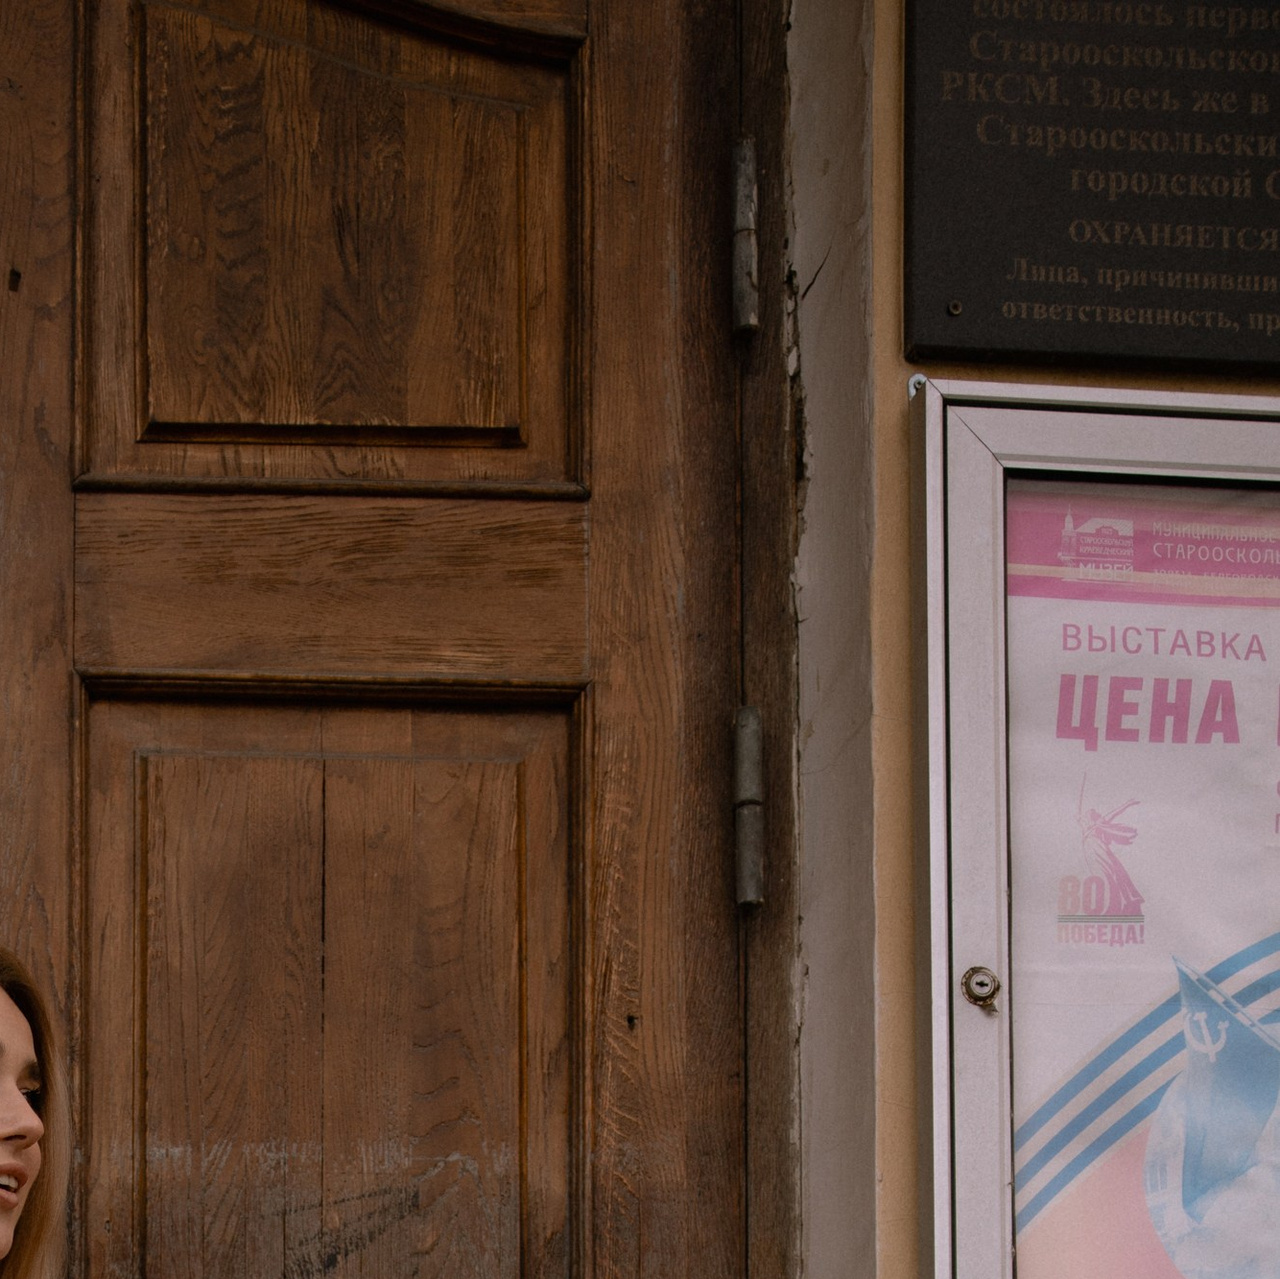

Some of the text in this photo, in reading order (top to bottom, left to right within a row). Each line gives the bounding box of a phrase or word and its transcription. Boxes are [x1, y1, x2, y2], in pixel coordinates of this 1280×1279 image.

[972, 0, 1174, 27] состоялось
[939, 70, 1270, 115] РКСМ. Здесь же в
[1070, 168, 1252, 200] городской
[1068, 219, 1279, 252] ОХРАНЯЕТСЯ
[1006, 257, 1089, 288] Лица,
[1002, 301, 1241, 333] ответственность,
[1152, 521, 1276, 543] МУНИЦИПАЛЬНОЕ
[1079, 562, 1134, 581] МУЗЕЙ
[1061, 622, 1267, 662] ВЫСТАВКА
[1055, 673, 1241, 752] ЦЕНА
[1057, 875, 1105, 916] 80
[1057, 923, 1145, 947] ПОБЕДА!
